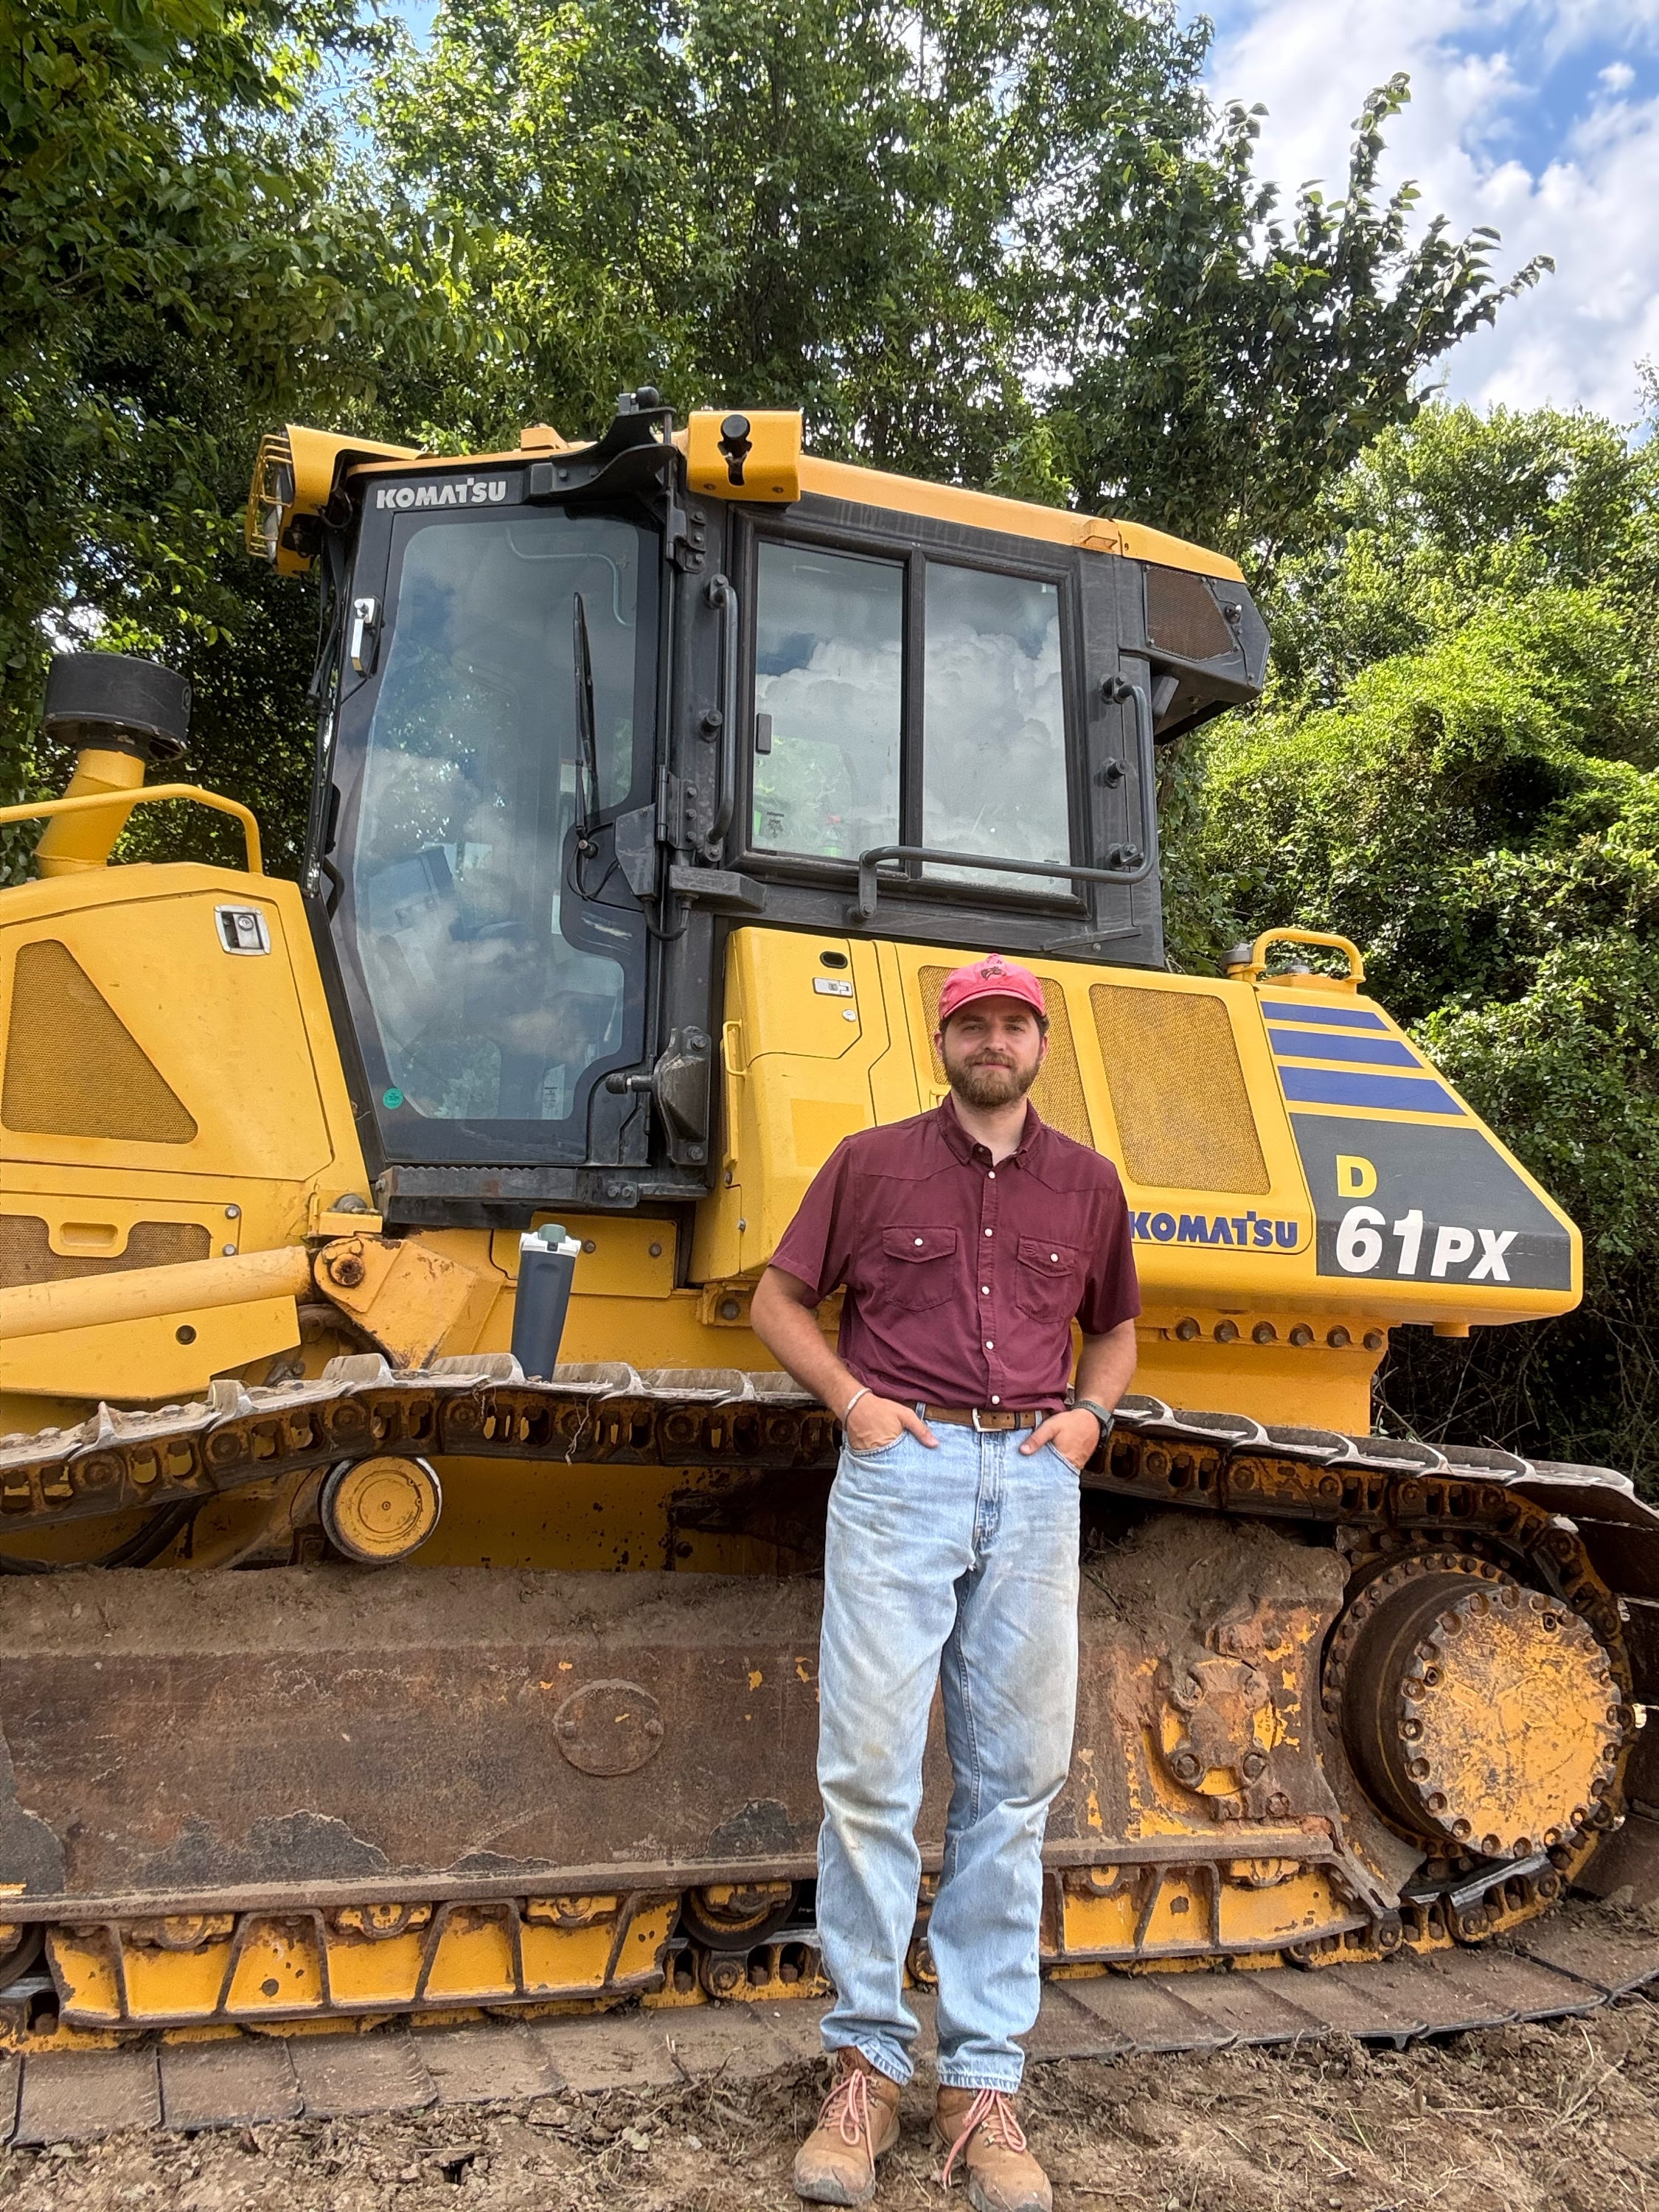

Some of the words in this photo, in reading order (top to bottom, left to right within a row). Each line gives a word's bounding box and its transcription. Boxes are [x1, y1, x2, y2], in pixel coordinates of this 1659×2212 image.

[376, 478, 507, 509] KOMATSU
[1335, 1155, 1377, 1198] D
[1129, 1211, 1298, 1248] KOMATSU
